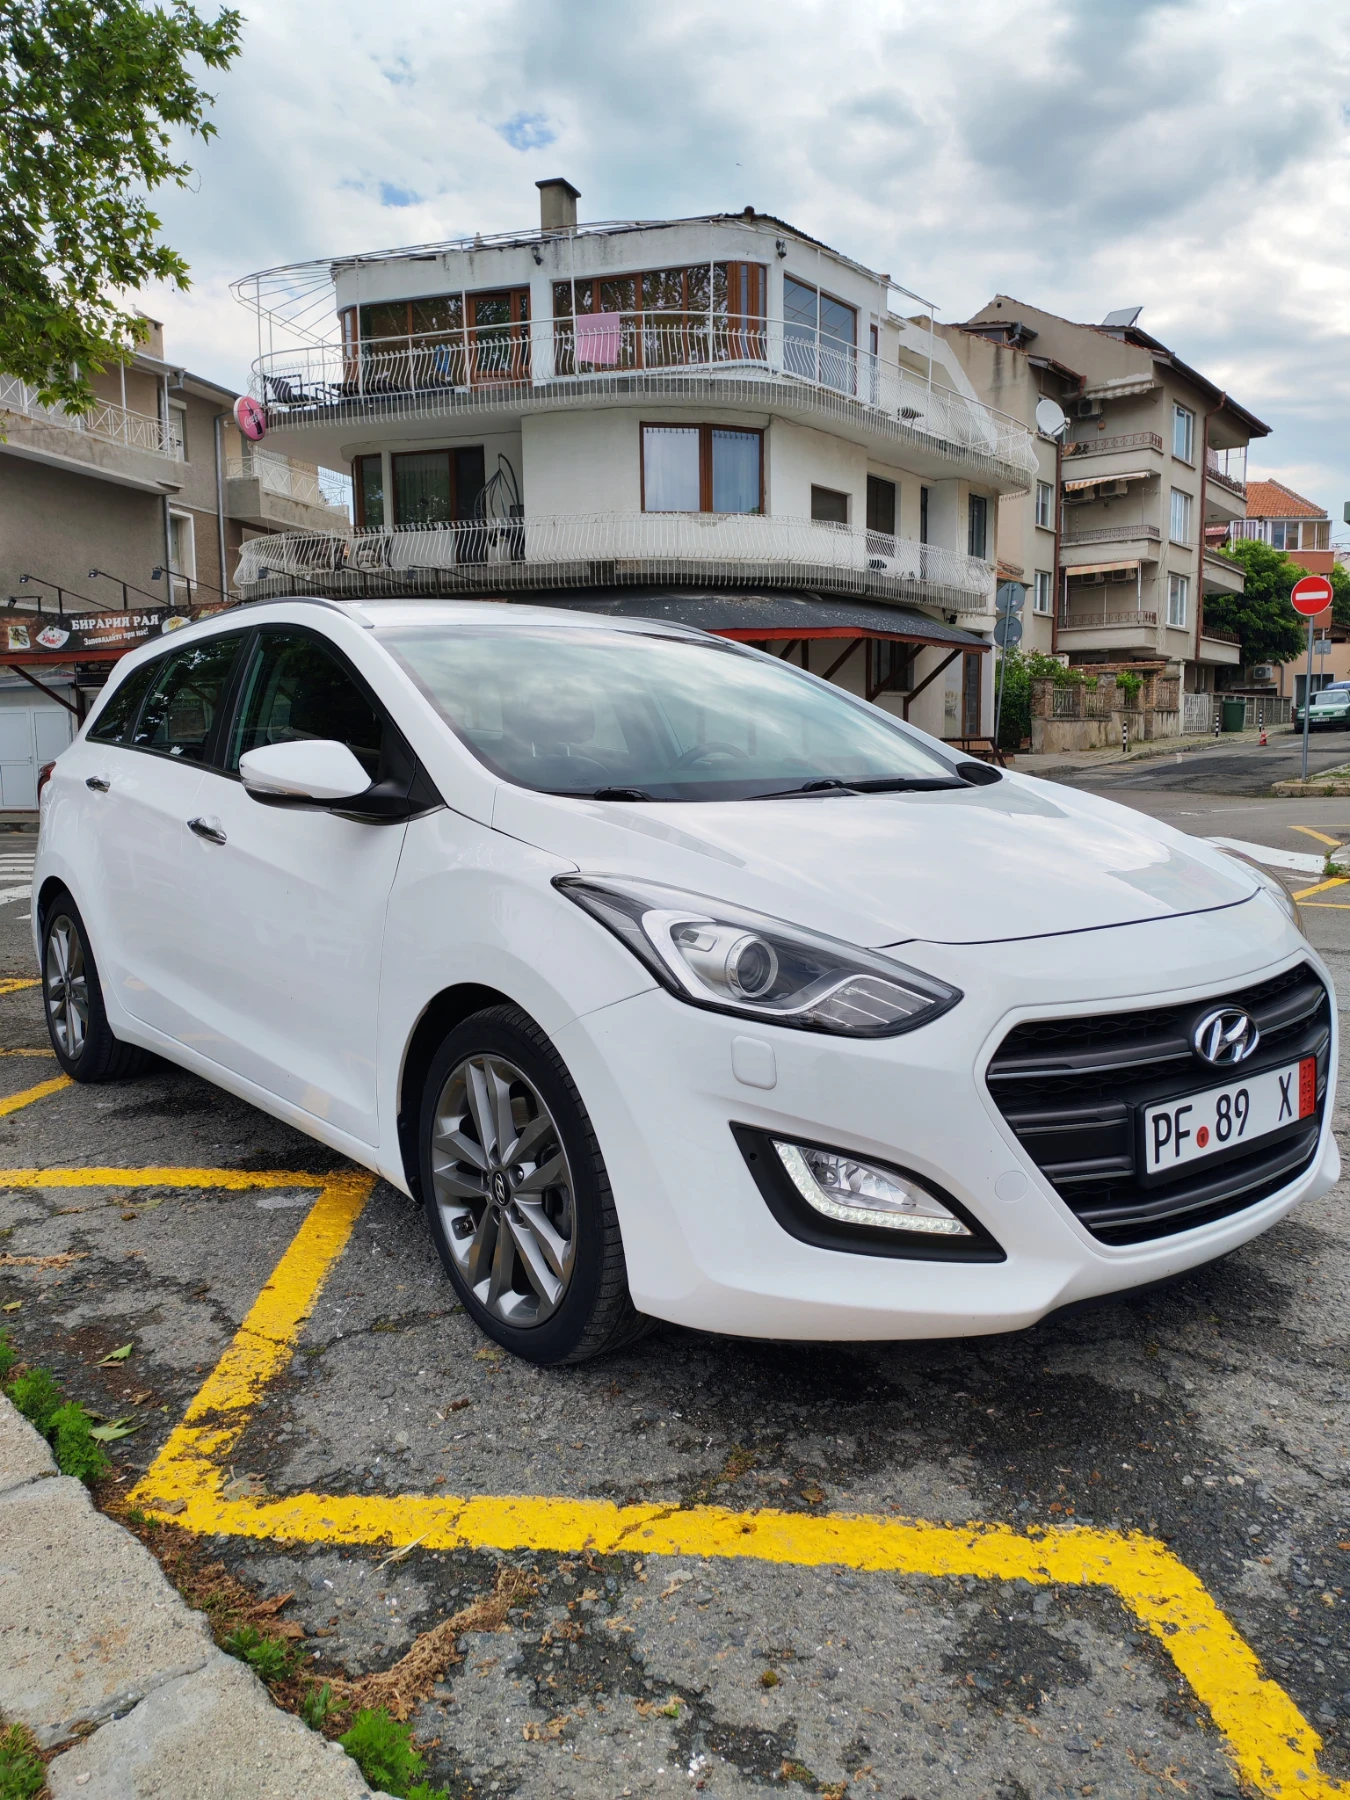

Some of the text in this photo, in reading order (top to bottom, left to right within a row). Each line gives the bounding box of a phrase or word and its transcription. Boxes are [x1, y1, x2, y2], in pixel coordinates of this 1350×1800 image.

[71, 614, 159, 630] БИРАРИЯ РАЯ
[1152, 1072, 1293, 1164] PF 89 X
